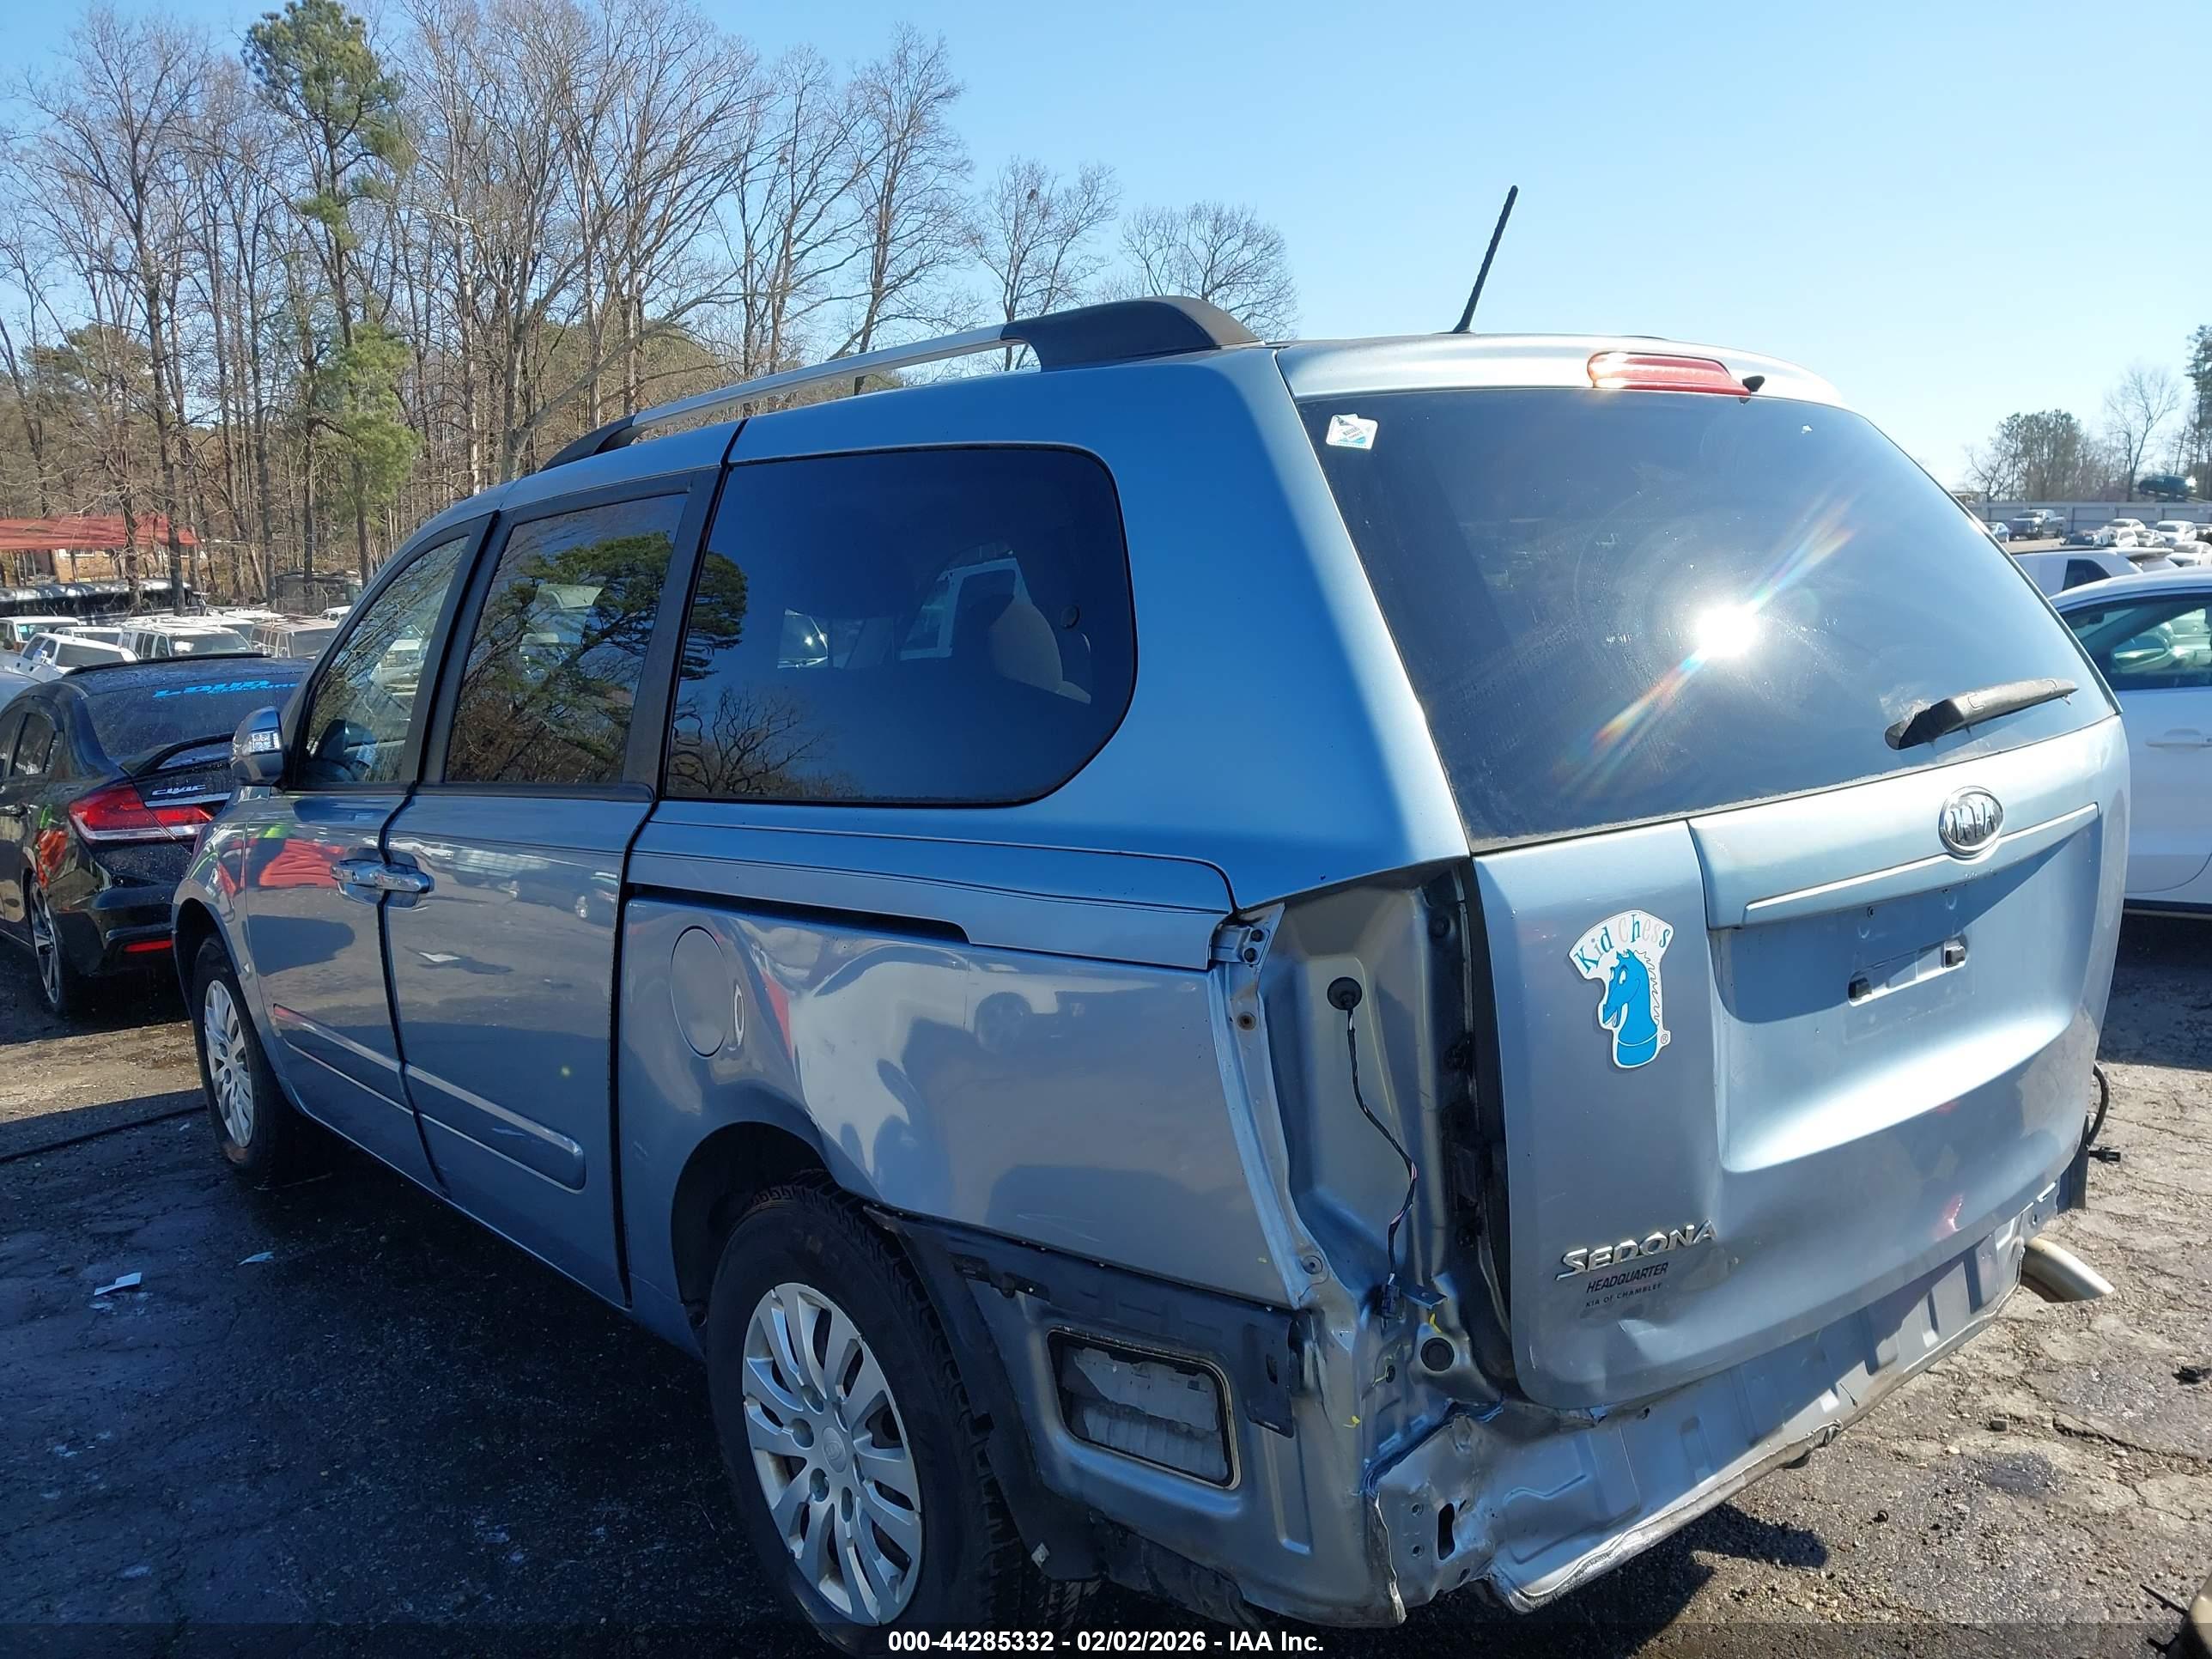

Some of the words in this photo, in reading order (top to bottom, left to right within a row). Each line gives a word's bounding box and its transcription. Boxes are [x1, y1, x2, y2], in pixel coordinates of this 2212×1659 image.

[152, 784, 207, 796] CIVIC
[1573, 926, 1613, 973] Kid
[1618, 914, 1671, 949] Chess
[1555, 1219, 1717, 1281] SEDONA
[1586, 1262, 1669, 1293] HEADQUARTER
